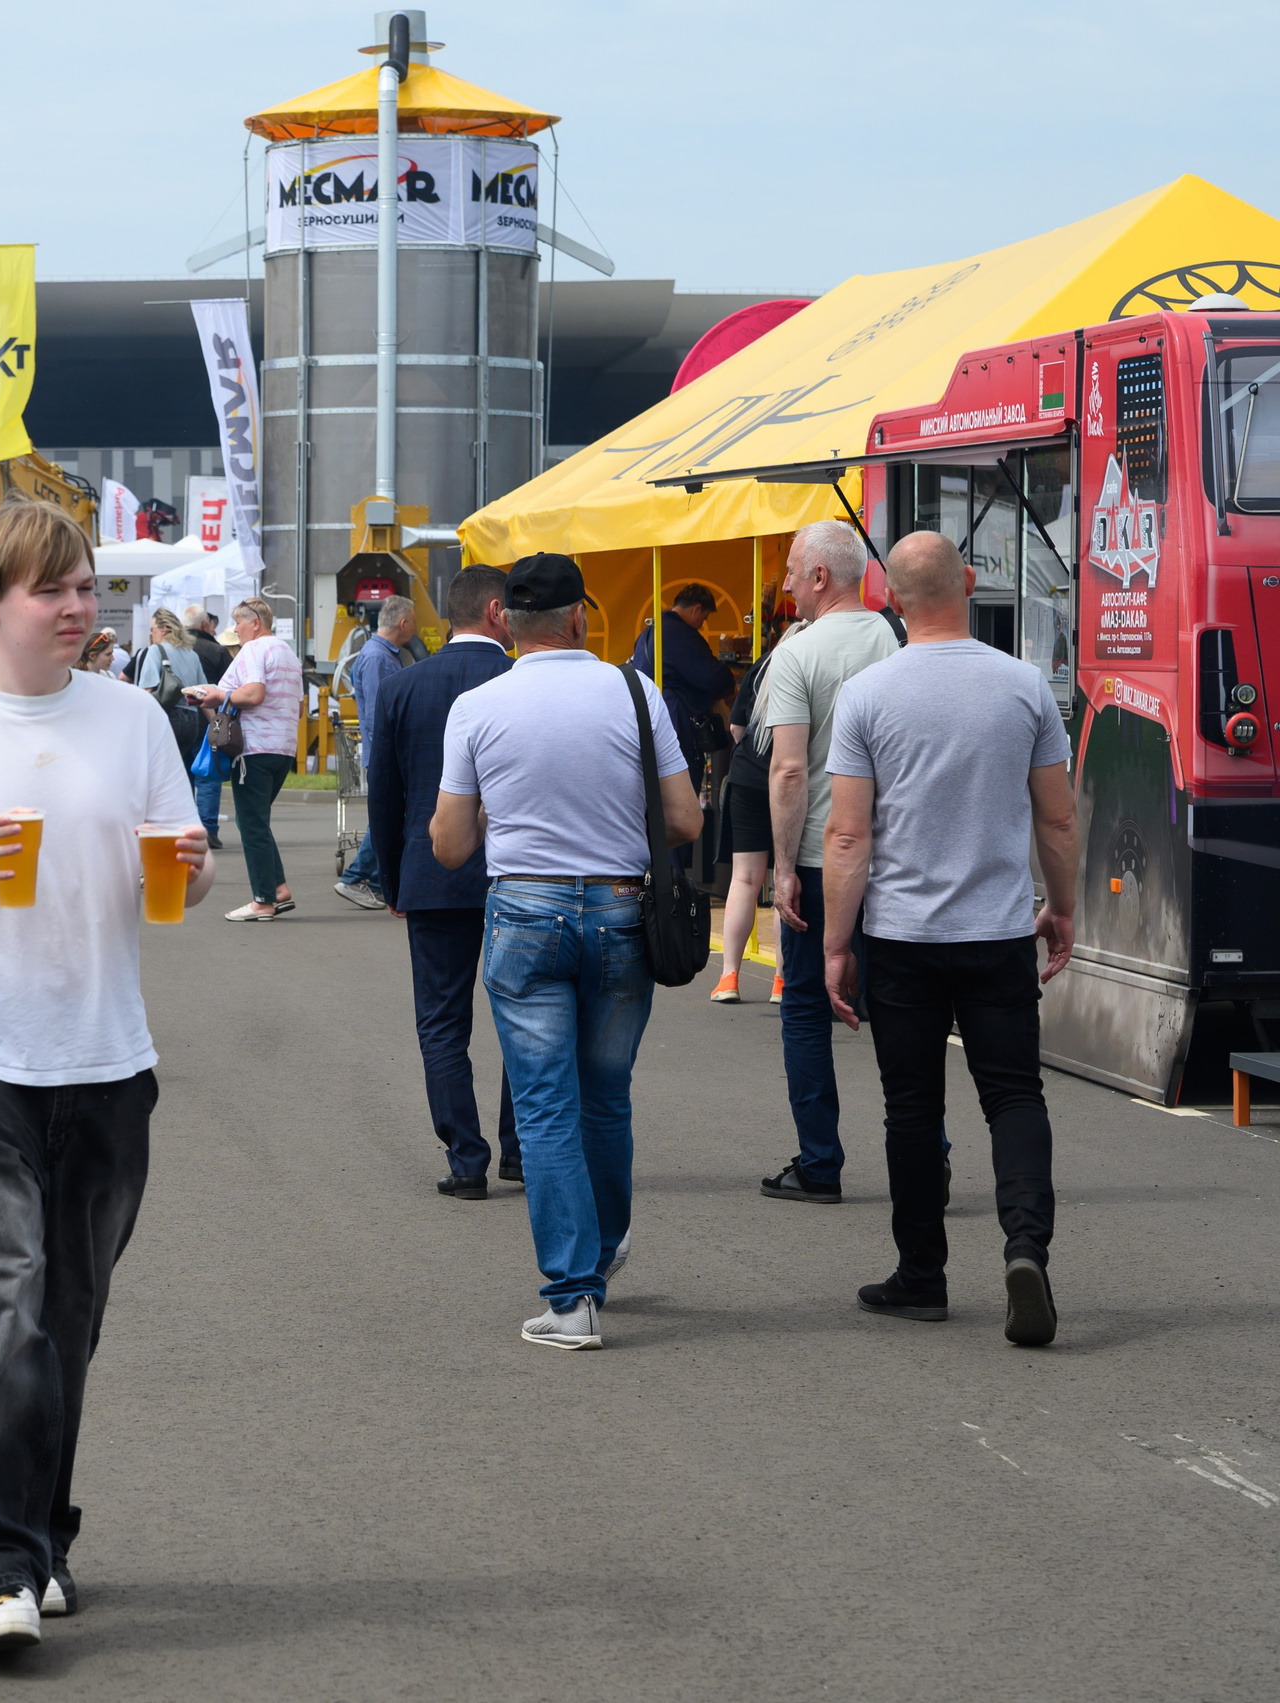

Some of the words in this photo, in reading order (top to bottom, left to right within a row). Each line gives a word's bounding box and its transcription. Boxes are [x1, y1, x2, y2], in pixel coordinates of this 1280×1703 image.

[919, 411, 948, 436] МИНСКИЙ
[949, 402, 1003, 432] АВТОМОБИЛЬНЫЙ
[1003, 403, 1026, 424] ЗАВОД
[1106, 480, 1118, 494] cafe
[108, 579, 130, 593] JKT
[1101, 591, 1147, 607] АВТОСПОРТ-КАФЕ
